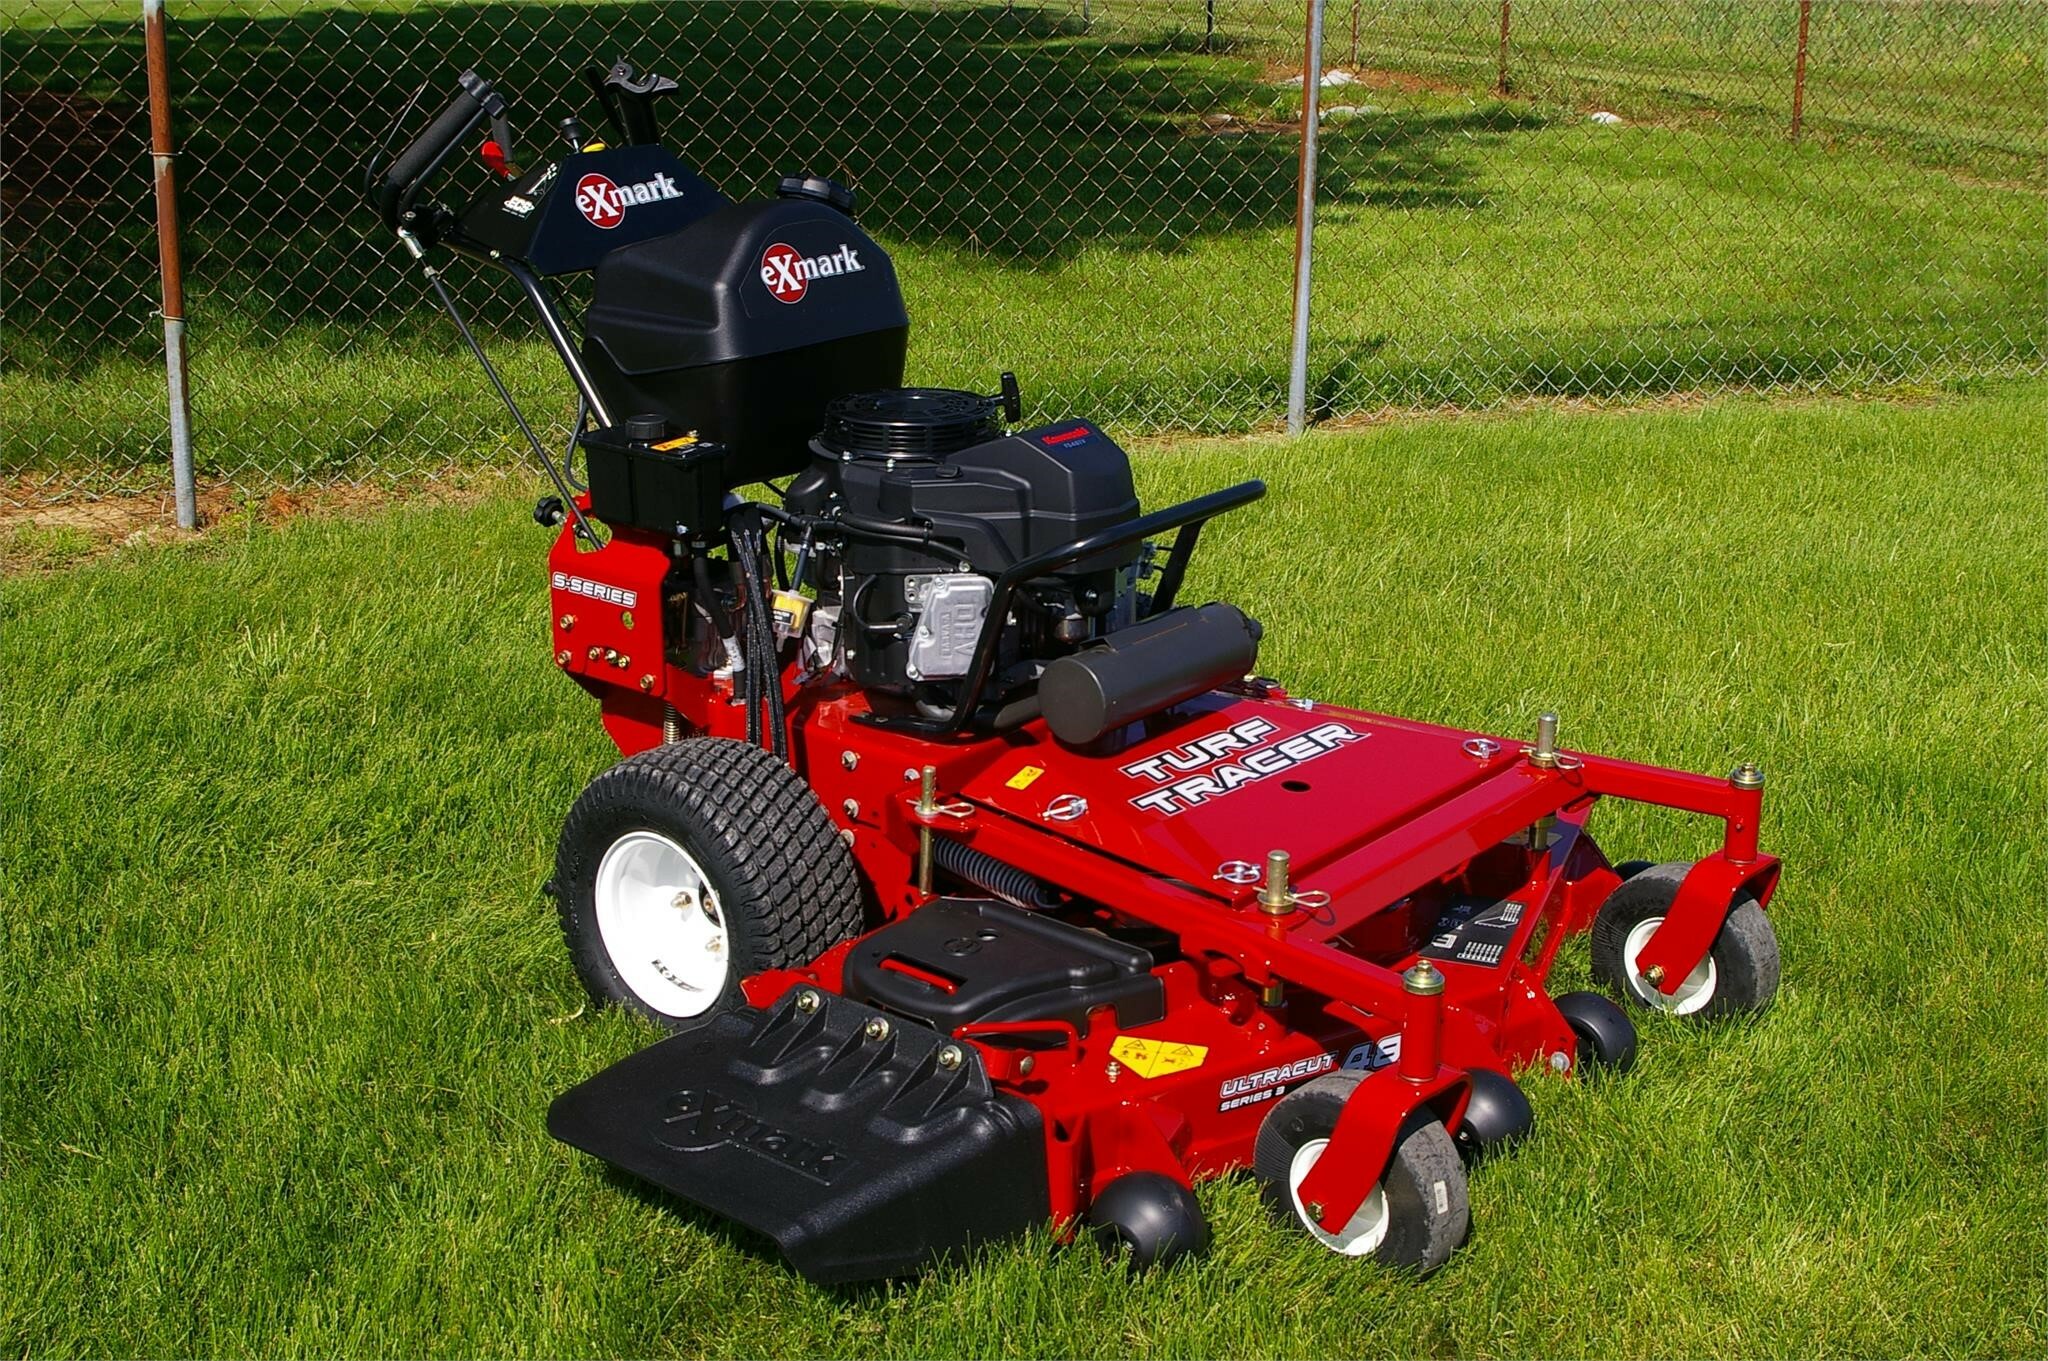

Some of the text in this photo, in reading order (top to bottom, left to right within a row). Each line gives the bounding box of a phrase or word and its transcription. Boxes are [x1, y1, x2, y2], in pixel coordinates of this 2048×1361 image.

[1121, 717, 1279, 782] TURF
[1132, 724, 1367, 815] TRACER
[1219, 1088, 1272, 1112] SERIES
[1221, 1051, 1338, 1097] ULTRACUT
